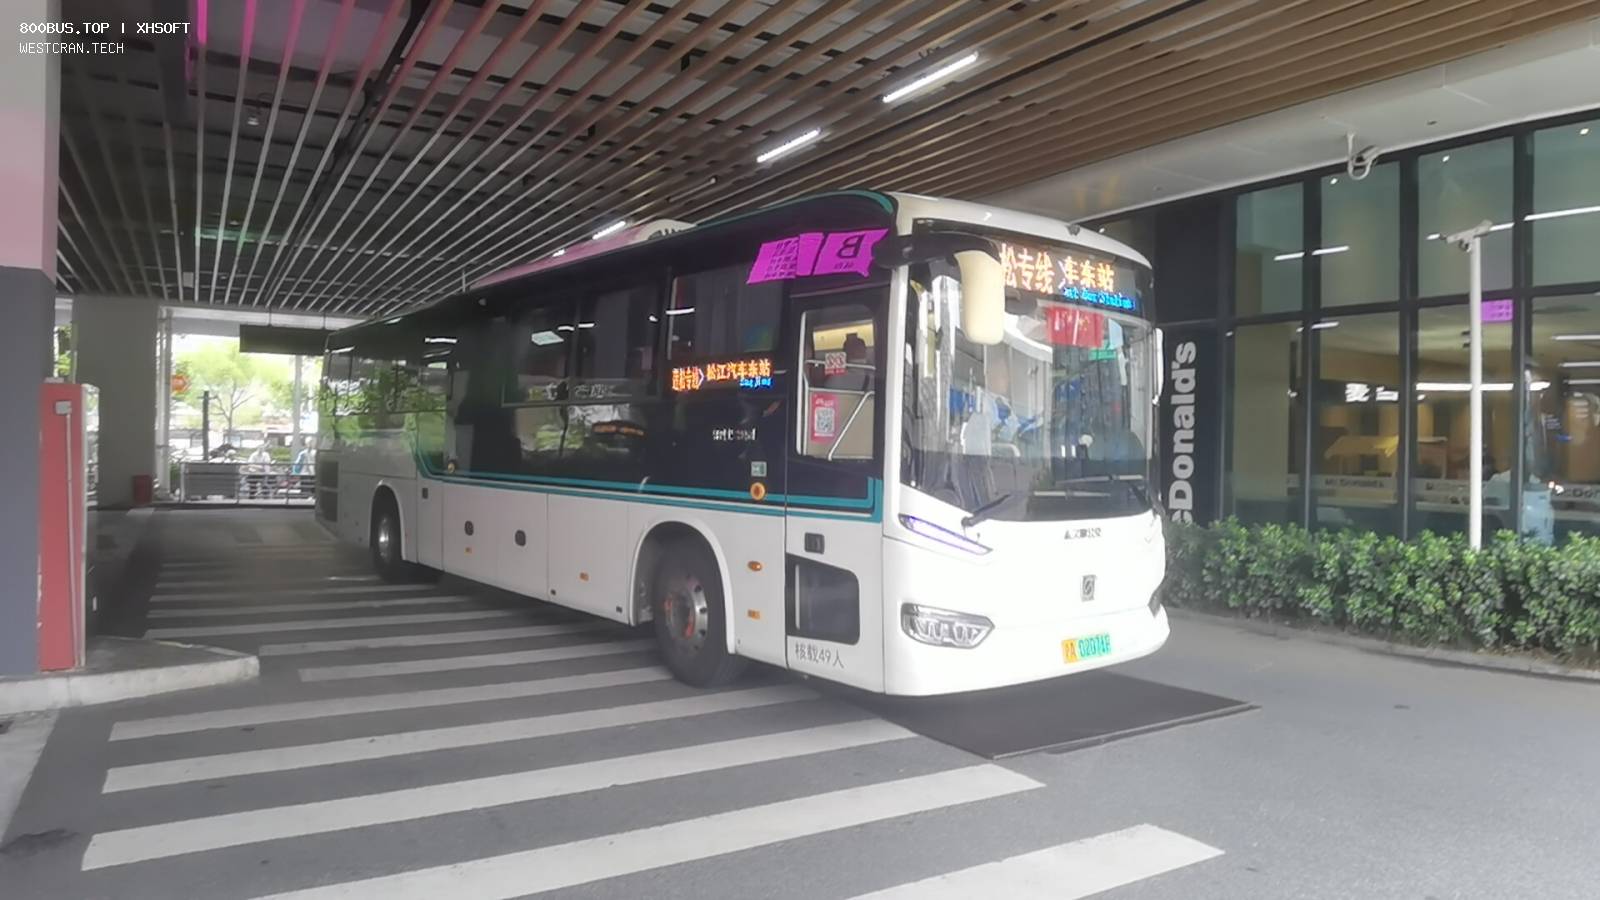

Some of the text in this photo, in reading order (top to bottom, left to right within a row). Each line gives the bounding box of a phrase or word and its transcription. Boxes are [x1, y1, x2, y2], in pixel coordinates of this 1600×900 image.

[706, 358, 771, 382] 松江汽车东站
[1168, 341, 1197, 527] cDonald's
[795, 642, 845, 669] 核载49人
